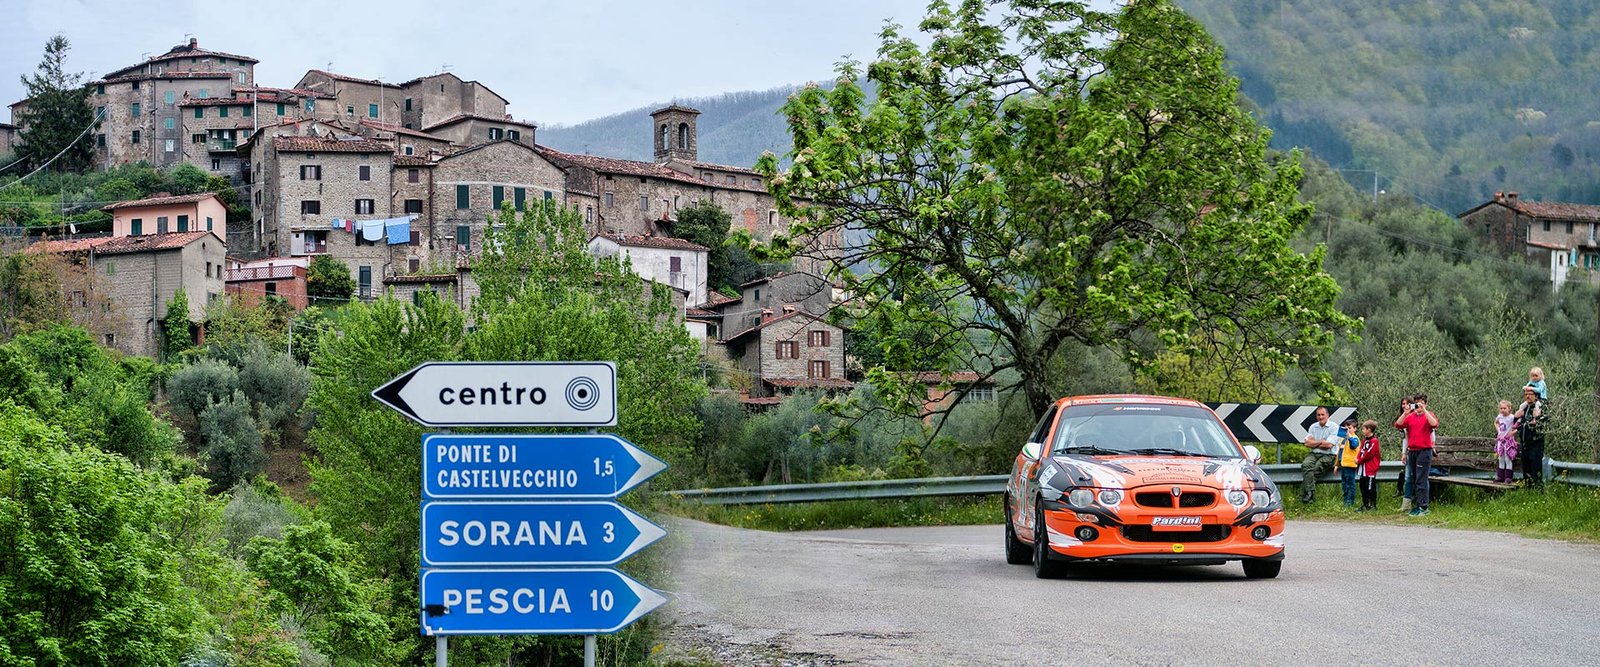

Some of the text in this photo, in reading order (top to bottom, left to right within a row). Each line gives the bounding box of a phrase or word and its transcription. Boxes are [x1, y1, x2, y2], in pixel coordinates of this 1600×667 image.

[438, 381, 547, 406] centro
[437, 444, 517, 463] PONTE DI
[437, 469, 578, 488] CASTELVECCHIO
[593, 457, 614, 478] 1,5
[438, 520, 615, 546] SORANA 3
[443, 588, 614, 614] PESCIA 10
